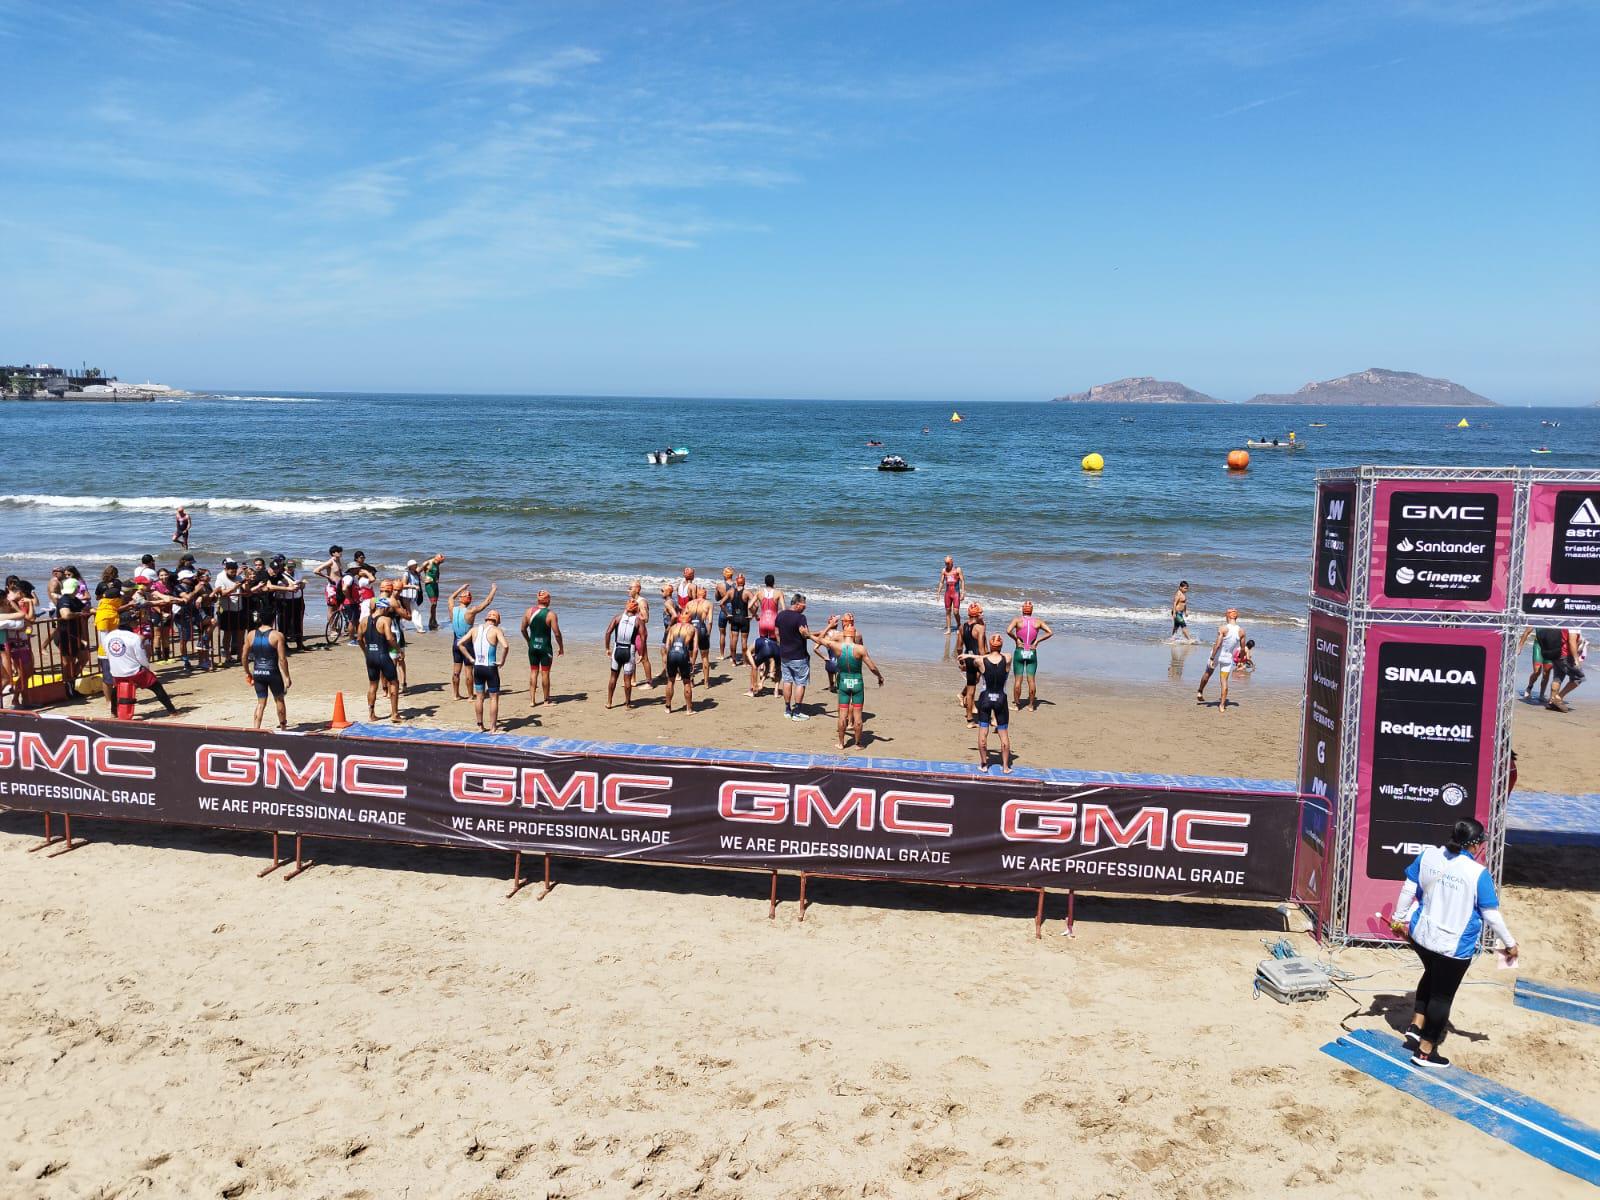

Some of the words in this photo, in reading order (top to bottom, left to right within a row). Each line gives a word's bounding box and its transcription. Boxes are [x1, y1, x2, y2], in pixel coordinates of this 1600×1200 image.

[1402, 505, 1485, 520] GMC
[1566, 528, 1600, 537] astr
[1415, 540, 1486, 554] Santander
[1416, 570, 1482, 583] Cinemex
[1316, 638, 1339, 656] GMC
[1385, 667, 1477, 685] SINALOA
[0, 730, 156, 779] MC
[195, 743, 409, 799] GMC
[11, 782, 110, 802] PROFESSIONAL
[112, 790, 156, 806] GRADE
[449, 761, 673, 818] GMC
[198, 796, 219, 811] WE
[222, 799, 249, 813] ARE
[252, 801, 355, 822] PROFESSIONAL
[358, 809, 406, 825] GRADE
[718, 780, 955, 837] GMC
[452, 816, 473, 831] WE
[476, 819, 505, 833] ARE
[508, 821, 618, 841] PROFESSIONAL
[621, 828, 671, 844] GRADE
[1000, 799, 1252, 857] GMC
[720, 835, 743, 850] WE
[746, 837, 776, 852] ARE
[780, 839, 895, 861] PROFESSIONAL
[899, 848, 950, 864] GRADE
[1381, 842, 1445, 855] VIB
[1001, 854, 1026, 869] WE
[1029, 857, 1061, 872] ARE
[1065, 859, 1187, 881] PROFESSIONAL
[1190, 868, 1245, 885] GRADE
